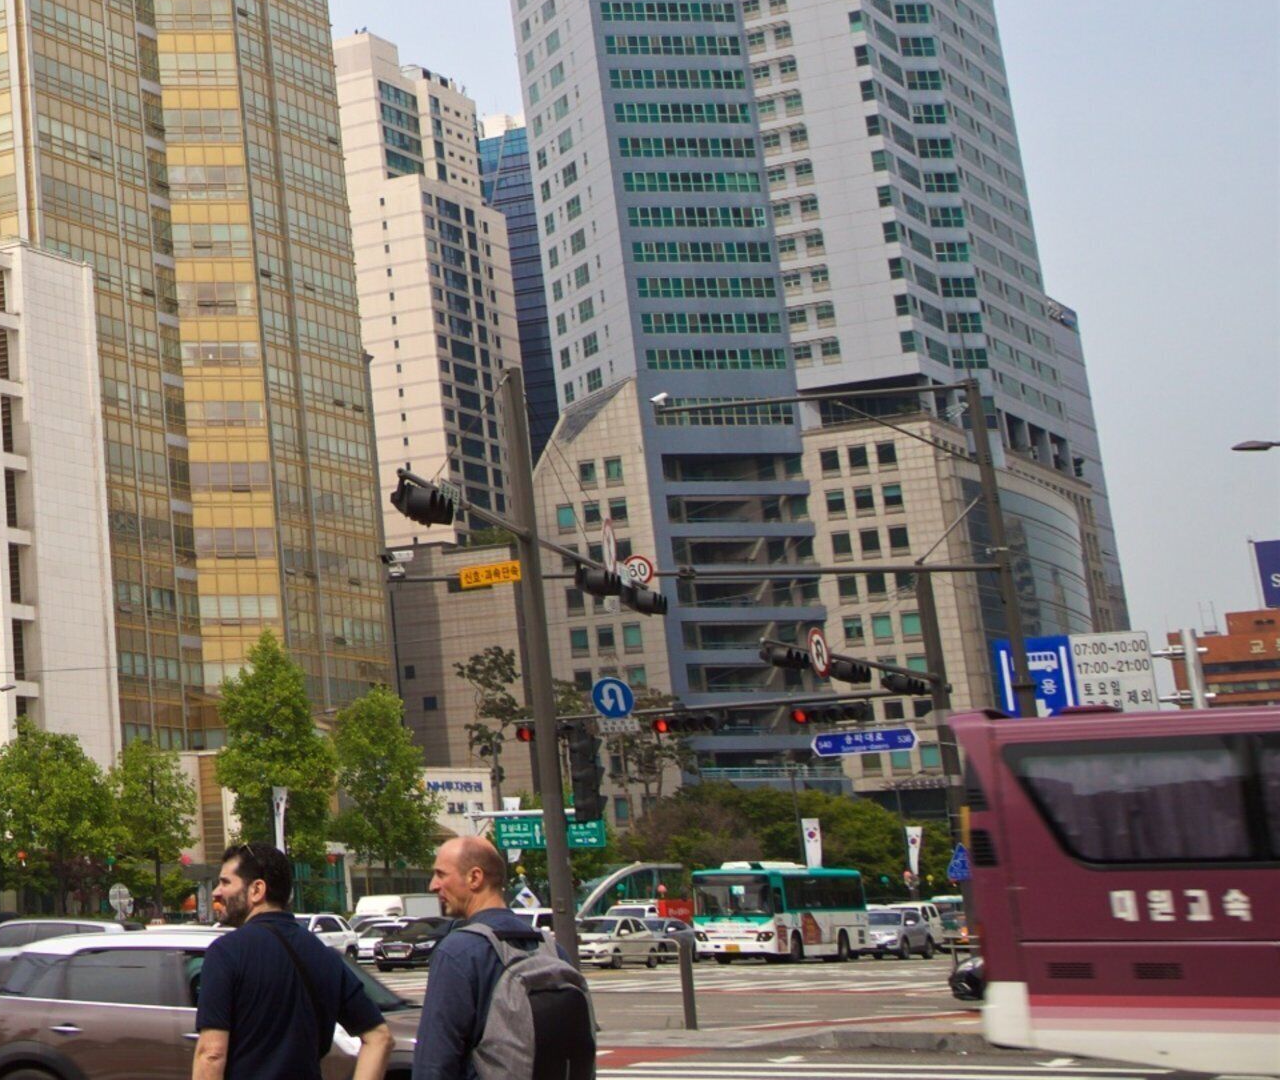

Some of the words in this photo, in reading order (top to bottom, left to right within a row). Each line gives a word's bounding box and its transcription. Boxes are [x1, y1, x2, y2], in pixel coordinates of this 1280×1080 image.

[1073, 639, 1147, 656] 07:00~10:00
[1077, 658, 1150, 675] 17:00~21:00
[1083, 680, 1121, 697] 토요일
[1126, 689, 1154, 704] 제외
[1109, 888, 1253, 922] 대원고속
